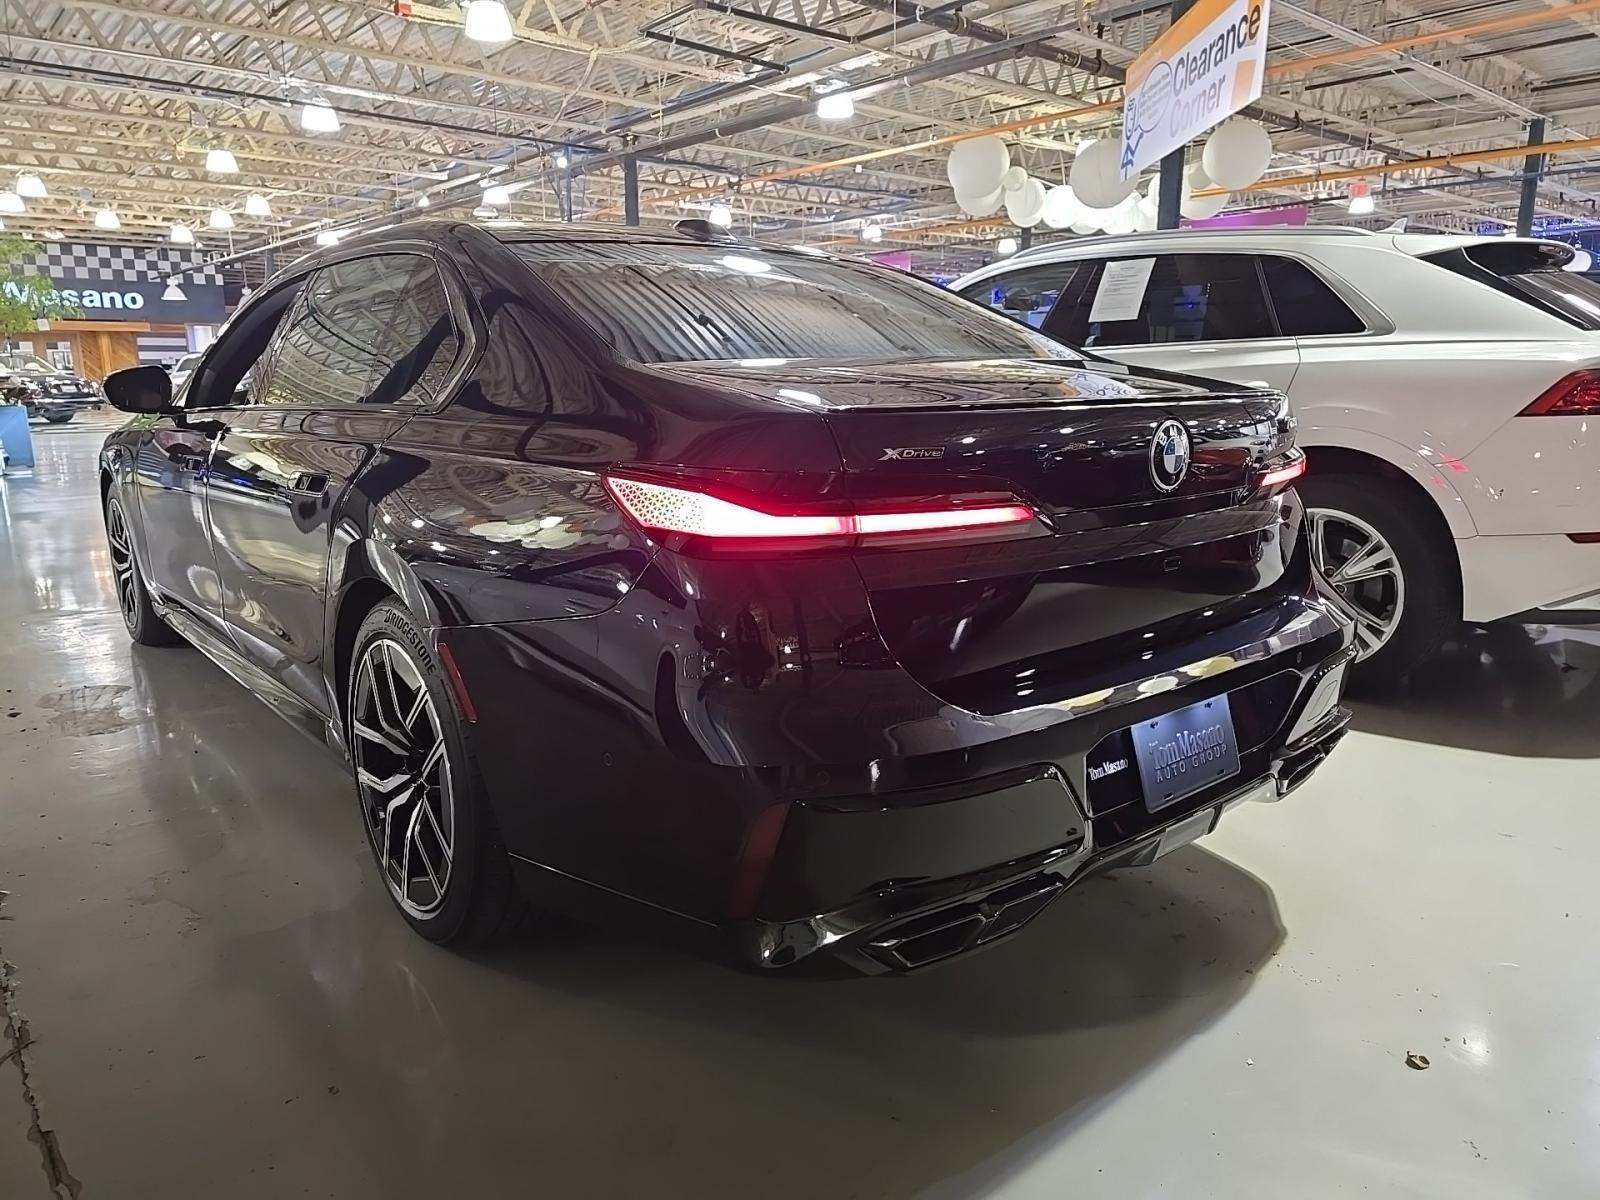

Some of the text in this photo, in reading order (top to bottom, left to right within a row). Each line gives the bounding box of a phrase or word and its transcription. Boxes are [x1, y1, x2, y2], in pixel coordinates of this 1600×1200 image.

[1173, 4, 1261, 97] Clearance
[1170, 74, 1226, 138] Corner
[384, 609, 437, 676] BRIDGESTONE
[1088, 758, 1129, 781] Tom Masano
[1149, 724, 1226, 770] Tom Masano
[1156, 745, 1228, 783] AUTO GROUP
